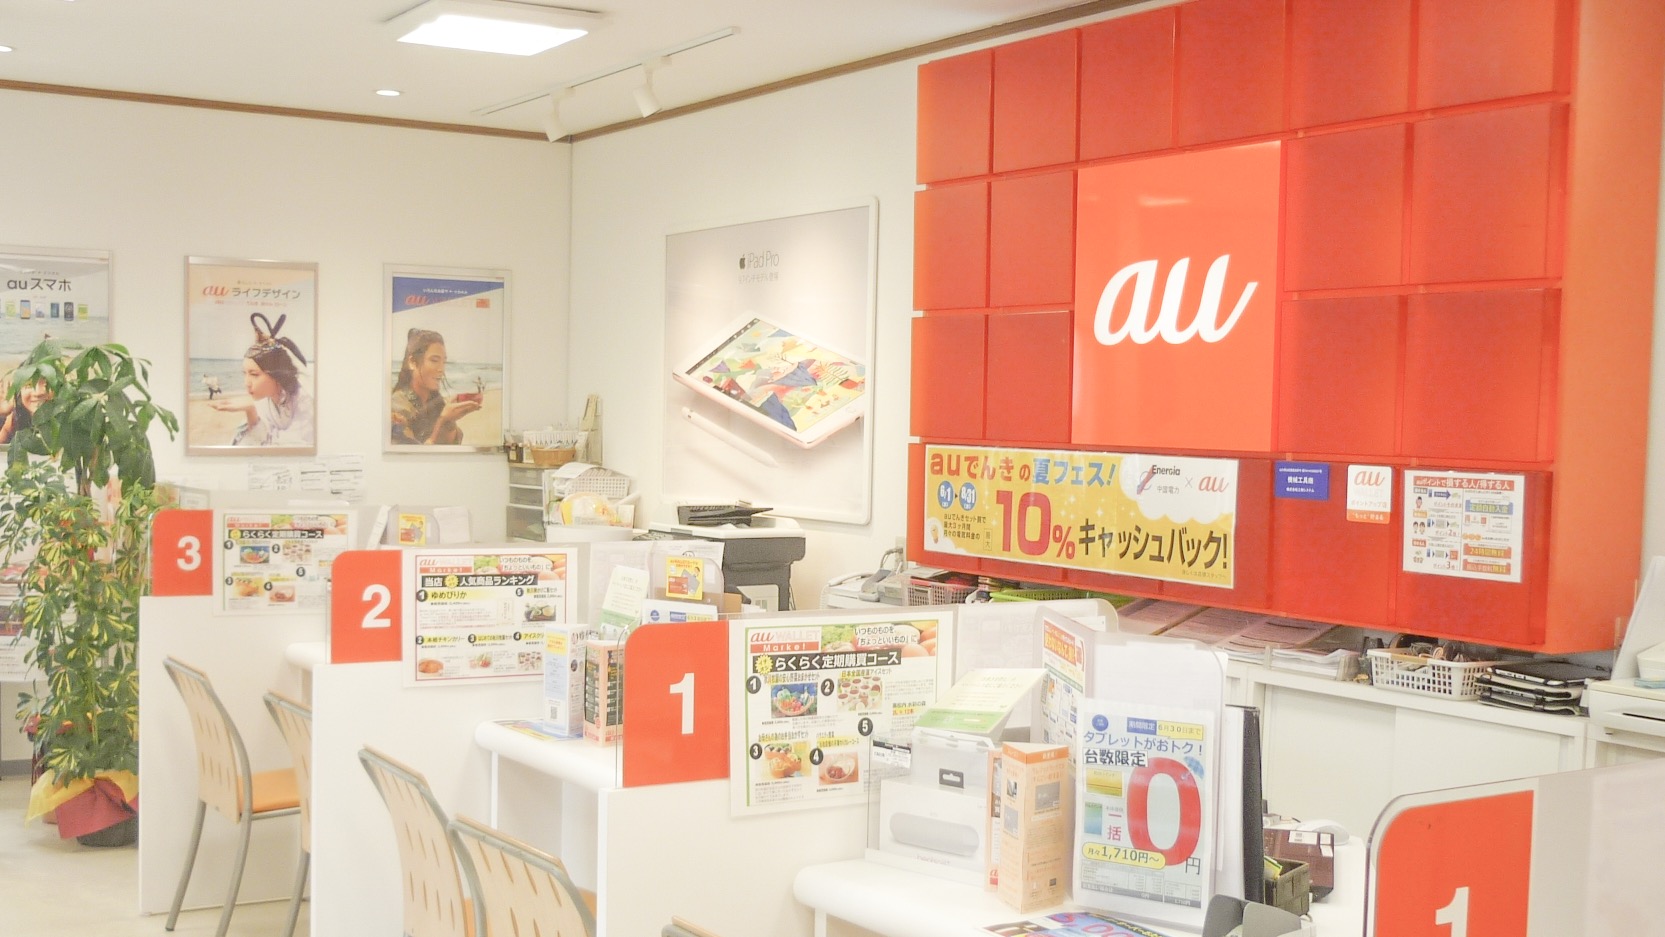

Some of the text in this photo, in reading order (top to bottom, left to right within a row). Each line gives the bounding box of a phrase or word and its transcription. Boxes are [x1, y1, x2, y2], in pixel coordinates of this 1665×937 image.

[747, 249, 780, 269] iPad Pro
[6, 277, 72, 292] auスマホ
[202, 285, 301, 300] au ライフデザイン
[1093, 254, 1259, 346] au
[1198, 474, 1230, 493] au
[1354, 470, 1386, 487] au
[995, 489, 1076, 560] 10%
[176, 535, 202, 571] 3
[424, 577, 443, 587] 当店
[459, 575, 536, 586] 人気商品ランキング
[361, 584, 391, 628] 2
[750, 630, 820, 643] au WALLET
[854, 625, 895, 636] いつものものを
[763, 642, 807, 652] Market
[775, 651, 899, 672] らくらく定期購買コース
[669, 672, 695, 735] 1
[1084, 748, 1147, 767] 台数限定
[1126, 756, 1201, 867] 0
[1185, 857, 1201, 876] 円
[1435, 886, 1470, 937] 1
